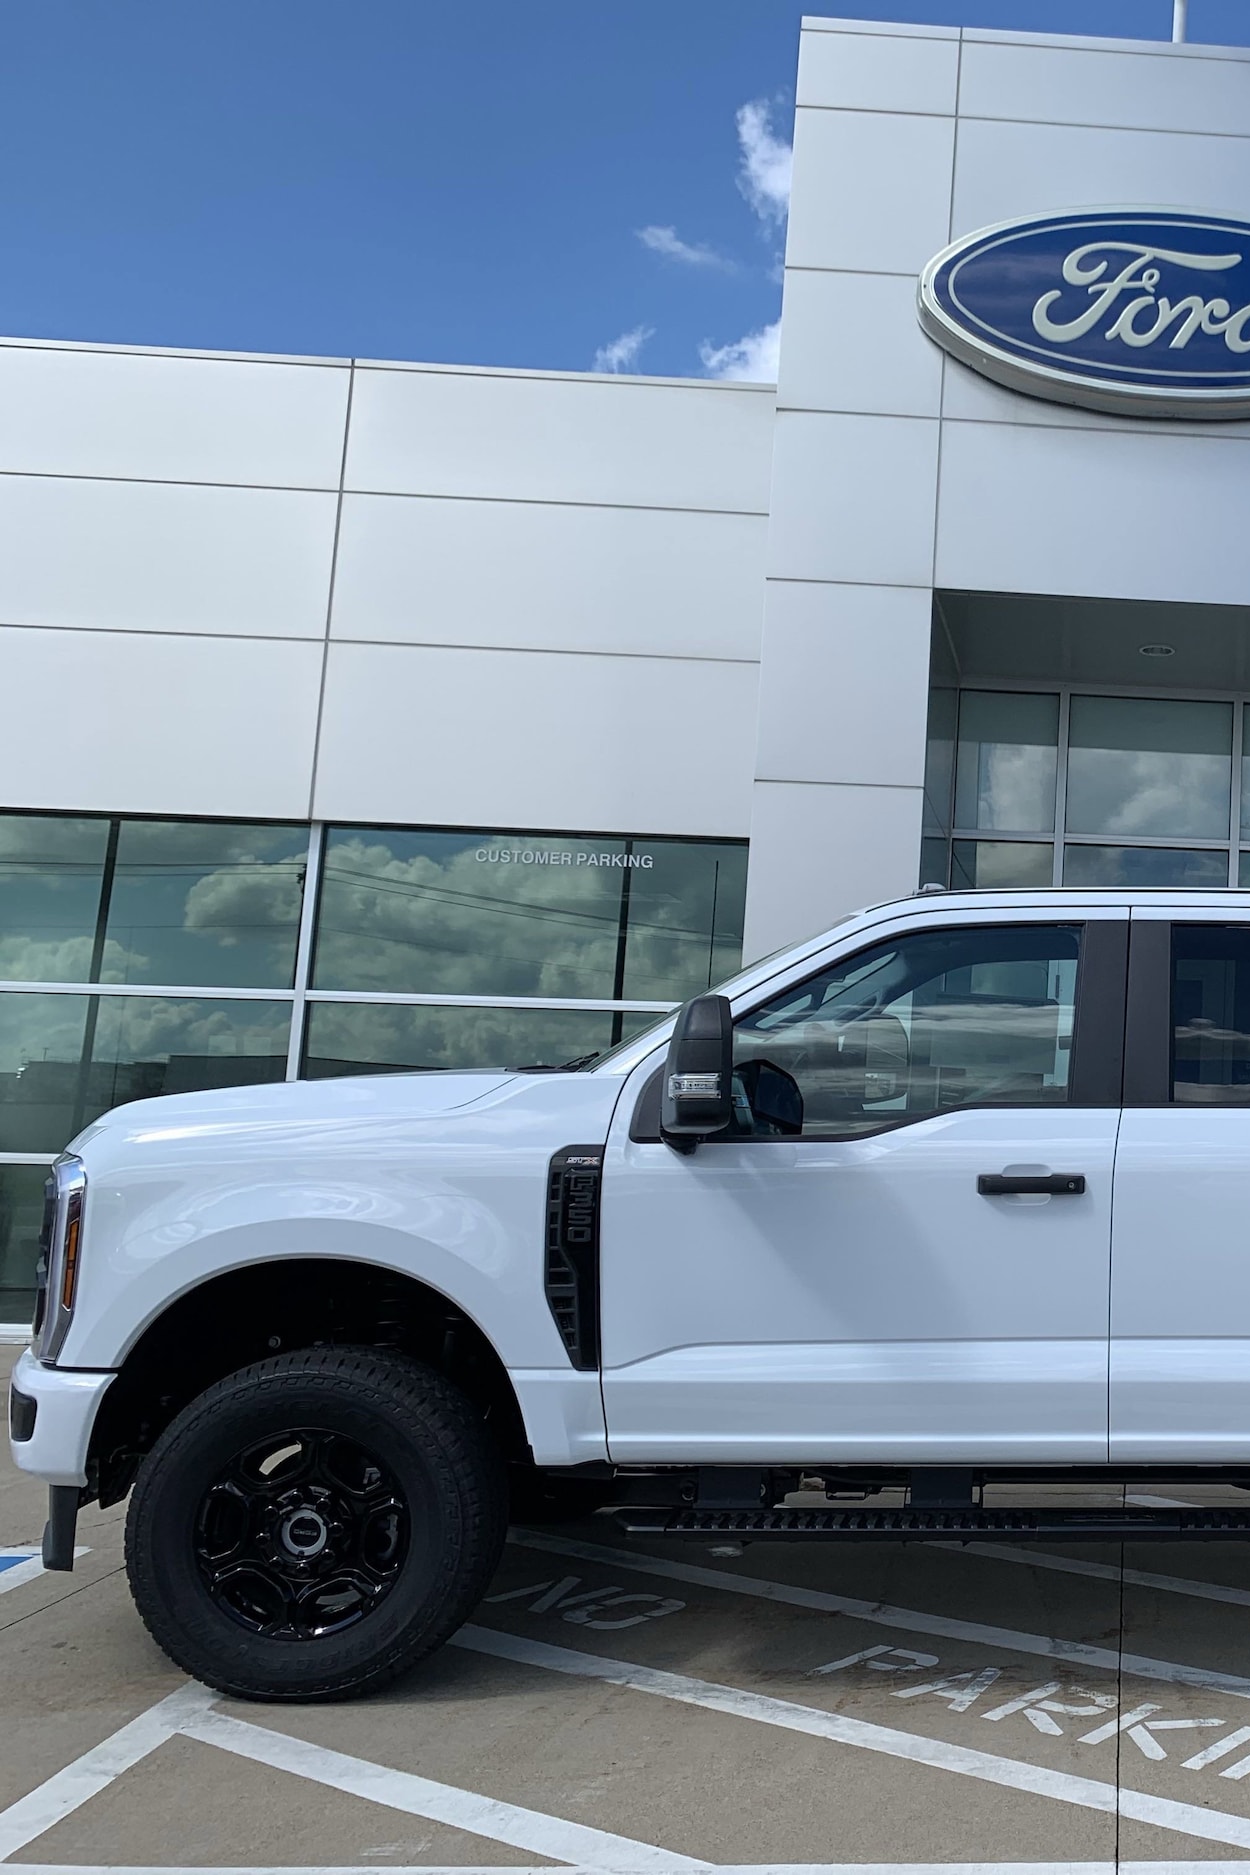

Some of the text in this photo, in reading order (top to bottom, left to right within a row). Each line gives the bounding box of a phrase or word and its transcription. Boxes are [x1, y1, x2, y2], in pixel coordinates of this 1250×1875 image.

[475, 849, 654, 869] CUSTOMER PARKING
[482, 1575, 687, 1630] NO
